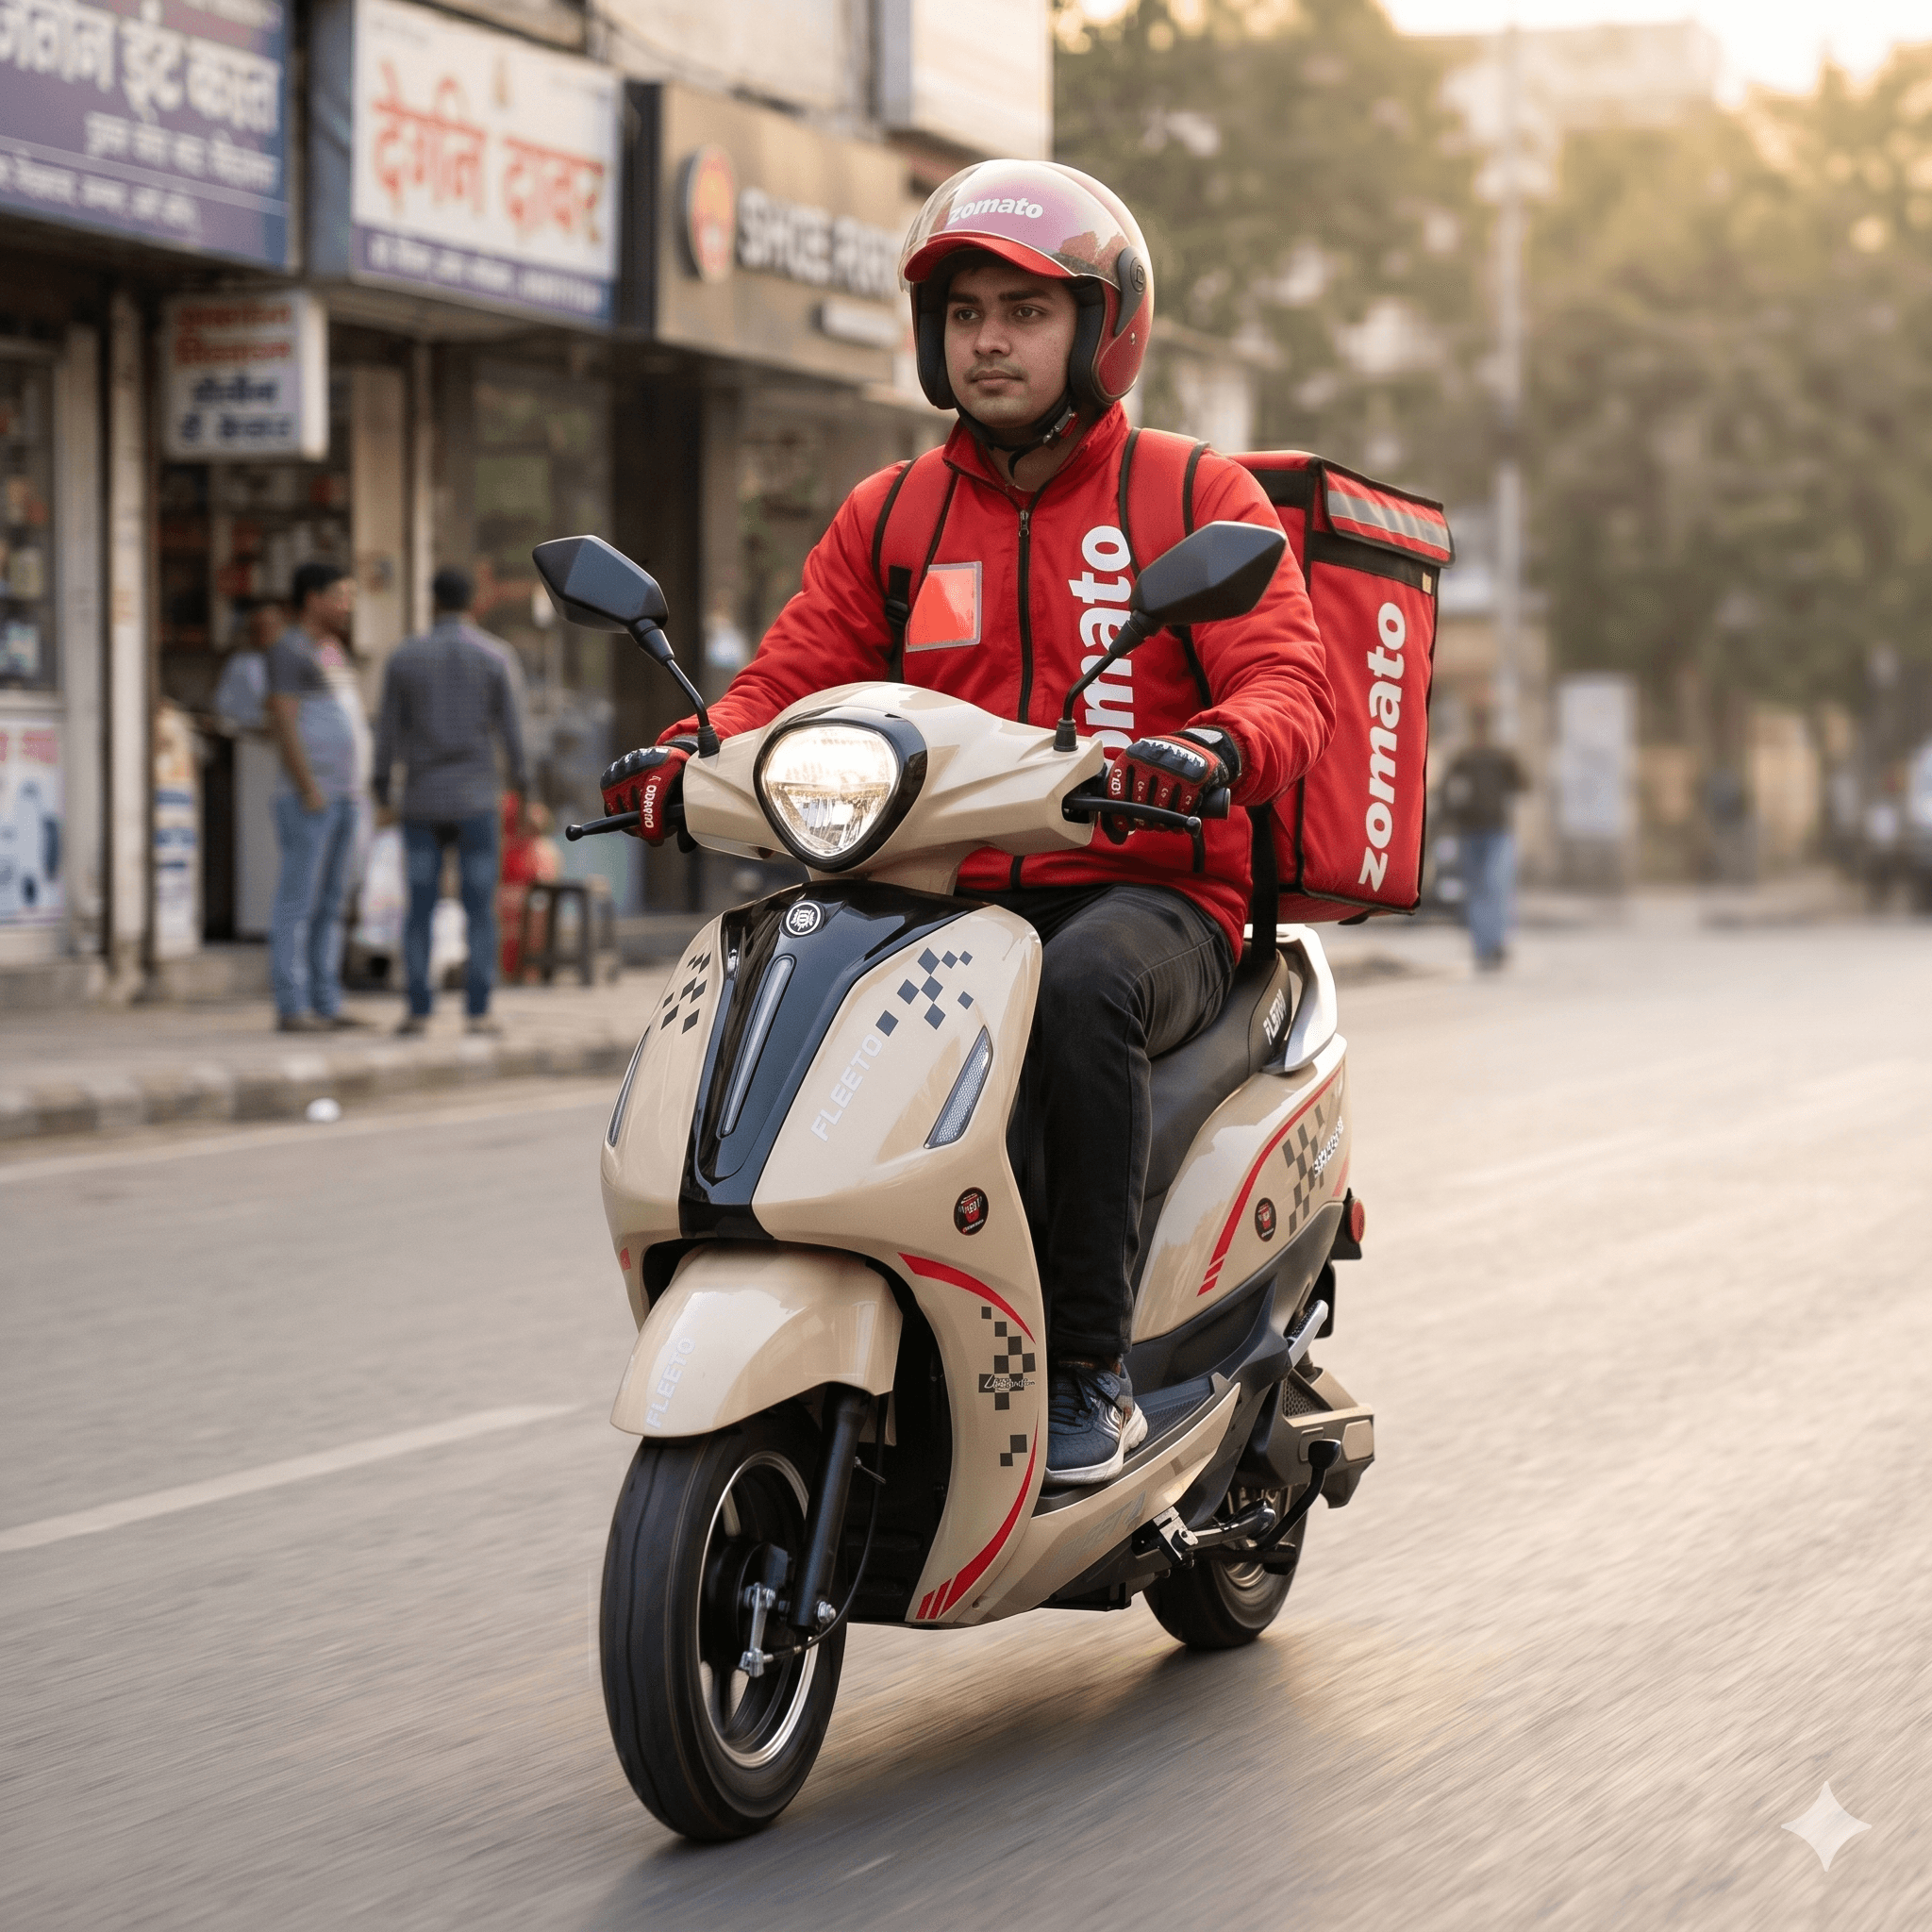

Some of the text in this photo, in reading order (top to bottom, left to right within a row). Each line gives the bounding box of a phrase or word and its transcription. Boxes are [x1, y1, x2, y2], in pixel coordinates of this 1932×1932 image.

[947, 197, 1043, 225] zomato
[1358, 602, 1407, 891] zomato
[810, 1033, 883, 1142] FLEETO
[645, 1337, 696, 1430] FLEETO
